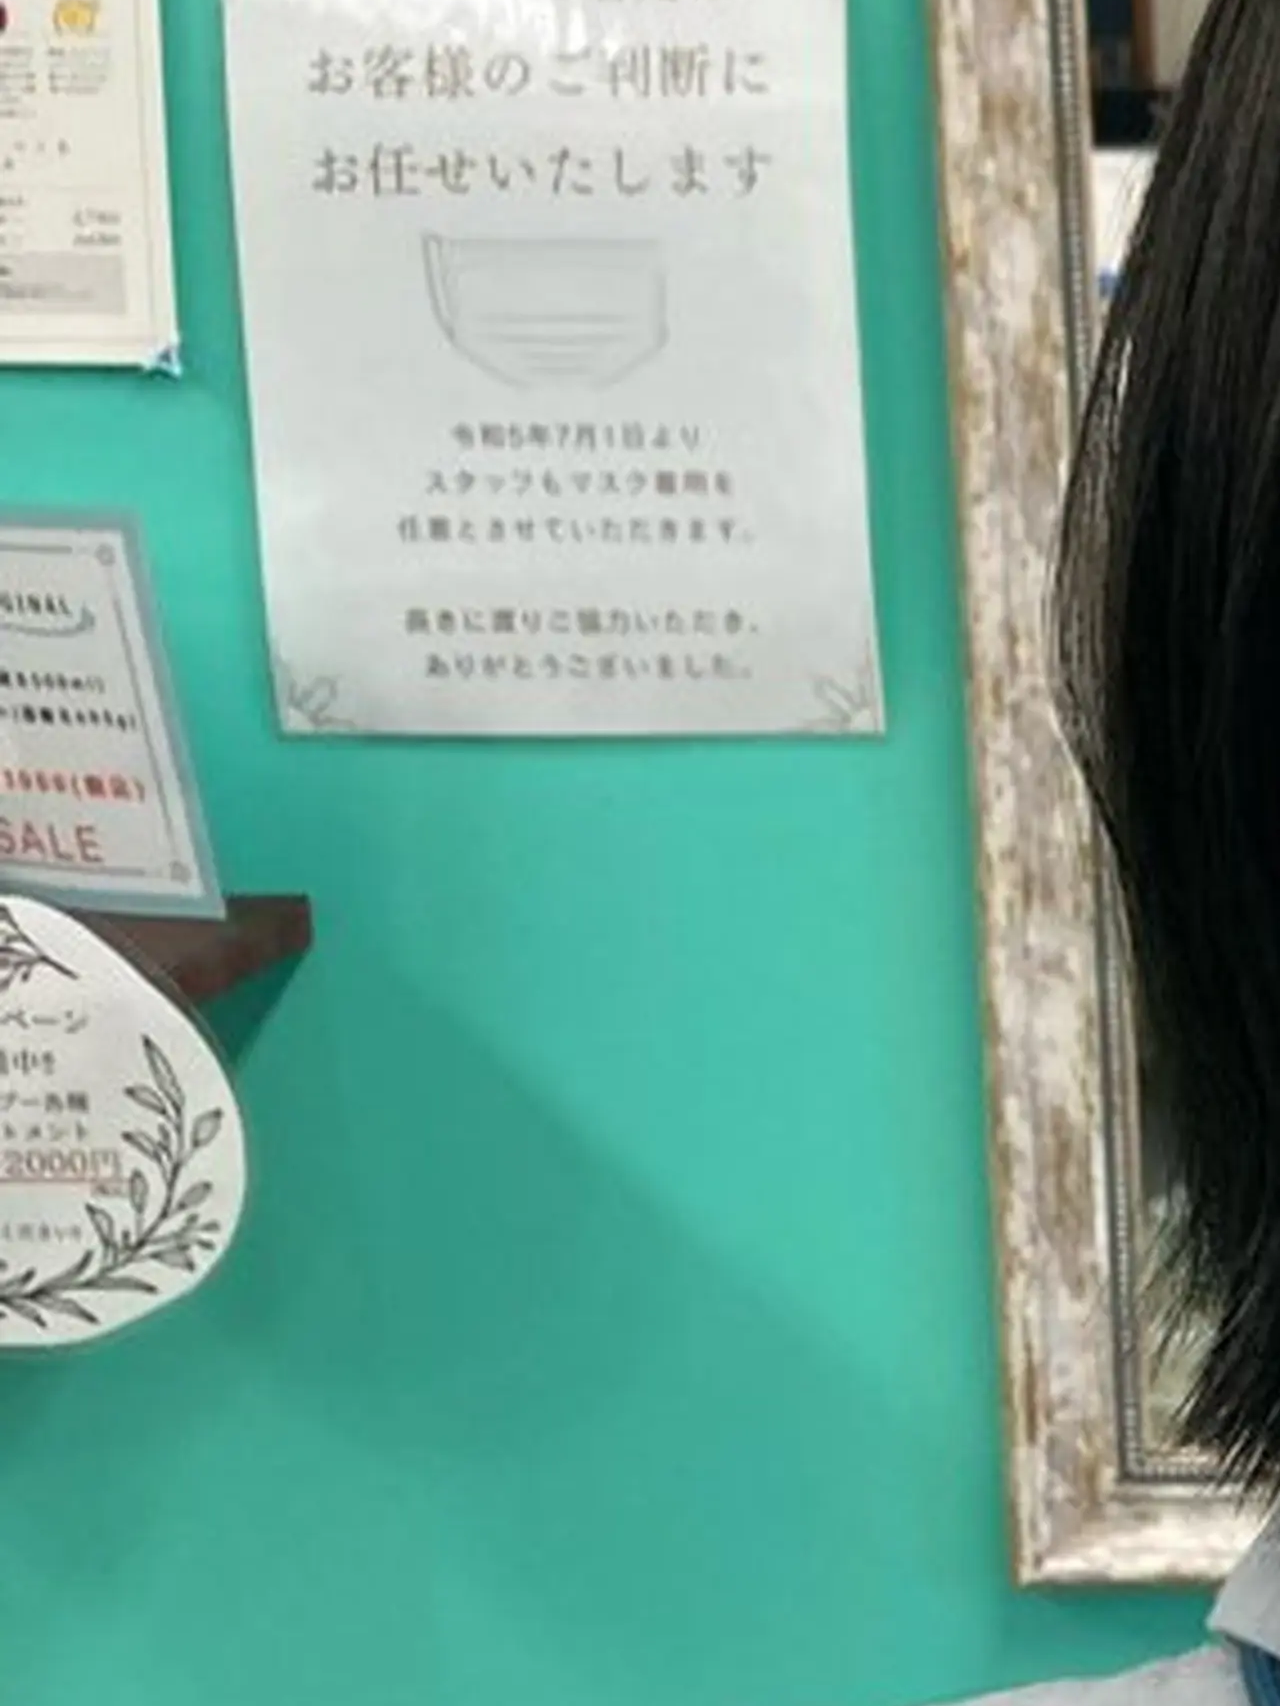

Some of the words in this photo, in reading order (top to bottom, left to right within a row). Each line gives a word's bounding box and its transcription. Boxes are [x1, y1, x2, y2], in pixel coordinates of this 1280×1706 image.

[308, 42, 772, 100] お客様のご判断に
[311, 143, 773, 197] お任せいたします
